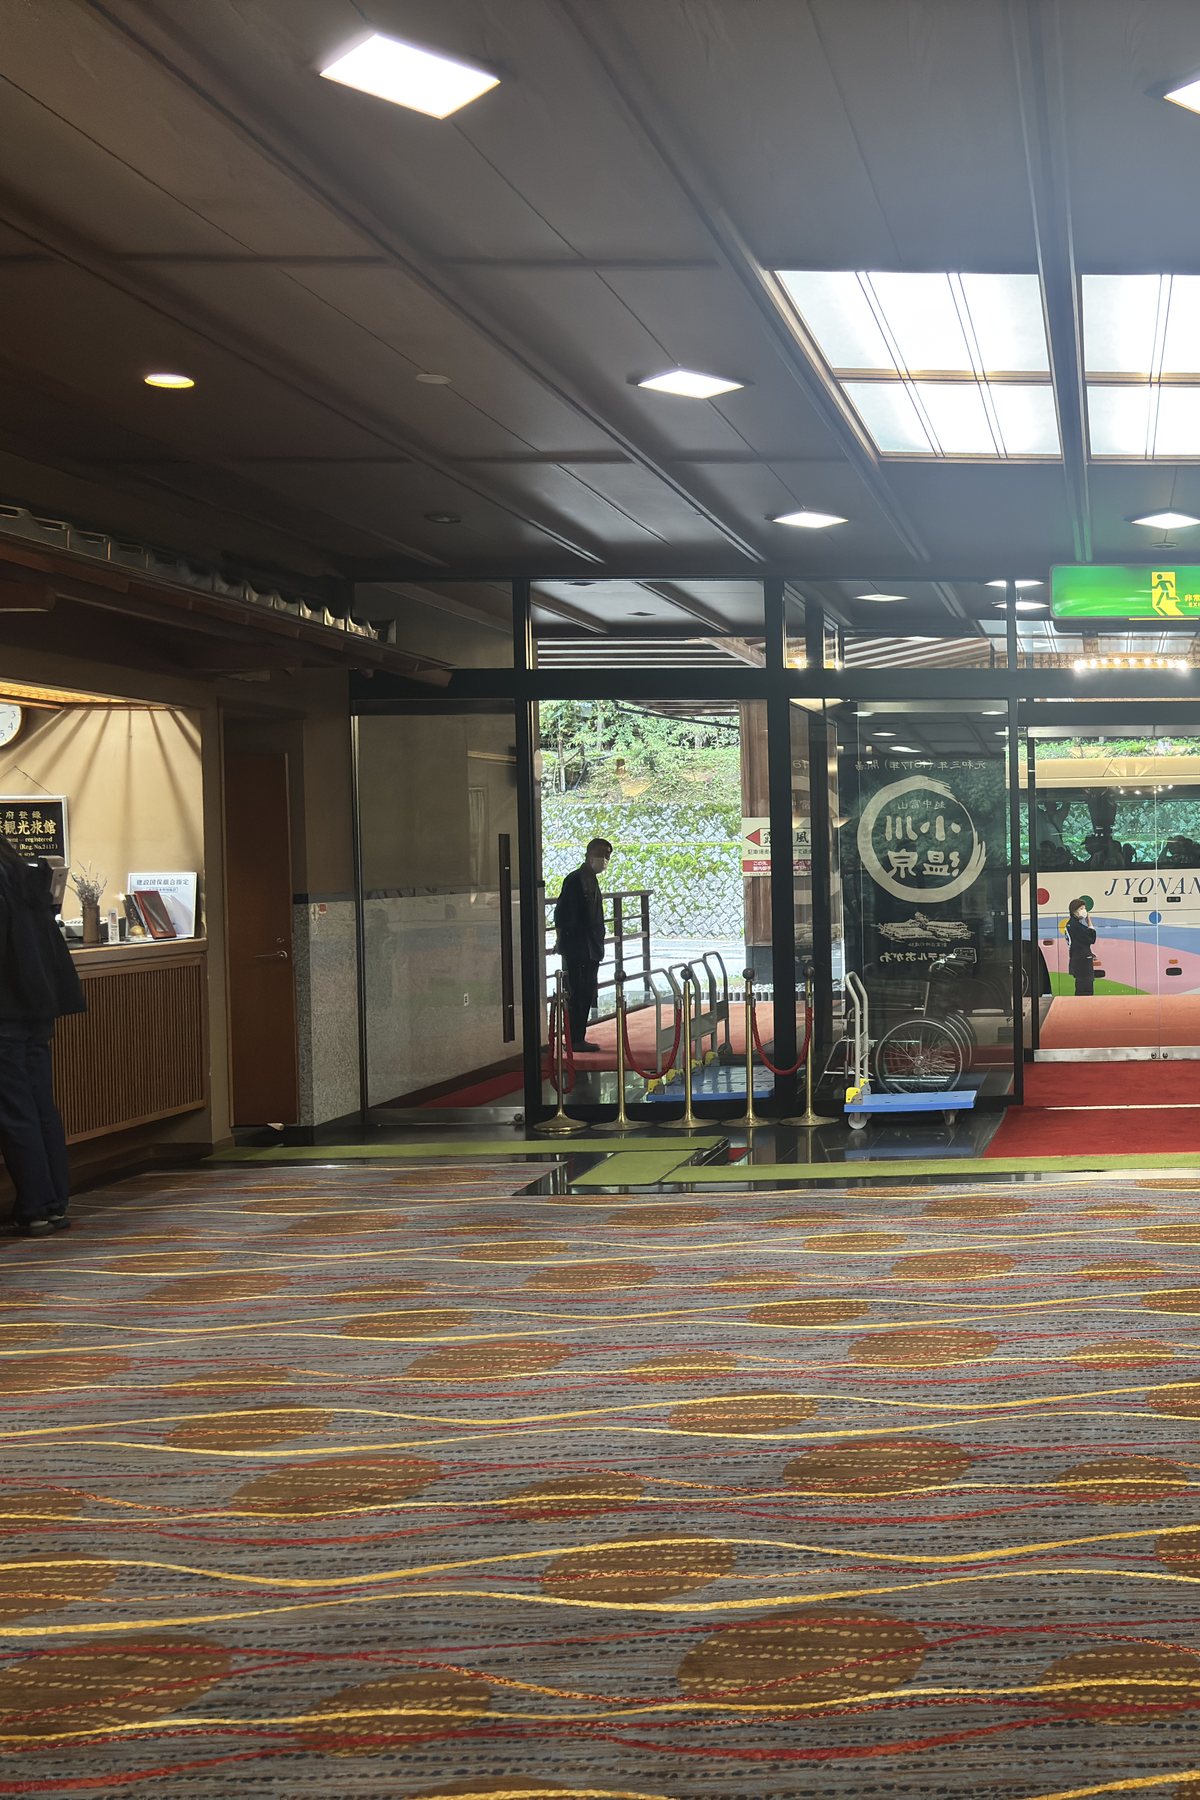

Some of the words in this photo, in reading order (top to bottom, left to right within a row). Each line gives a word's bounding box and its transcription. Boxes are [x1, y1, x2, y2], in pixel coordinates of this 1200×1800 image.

[0, 810, 42, 819] 府登録
[0, 820, 57, 835] 観光旅館
